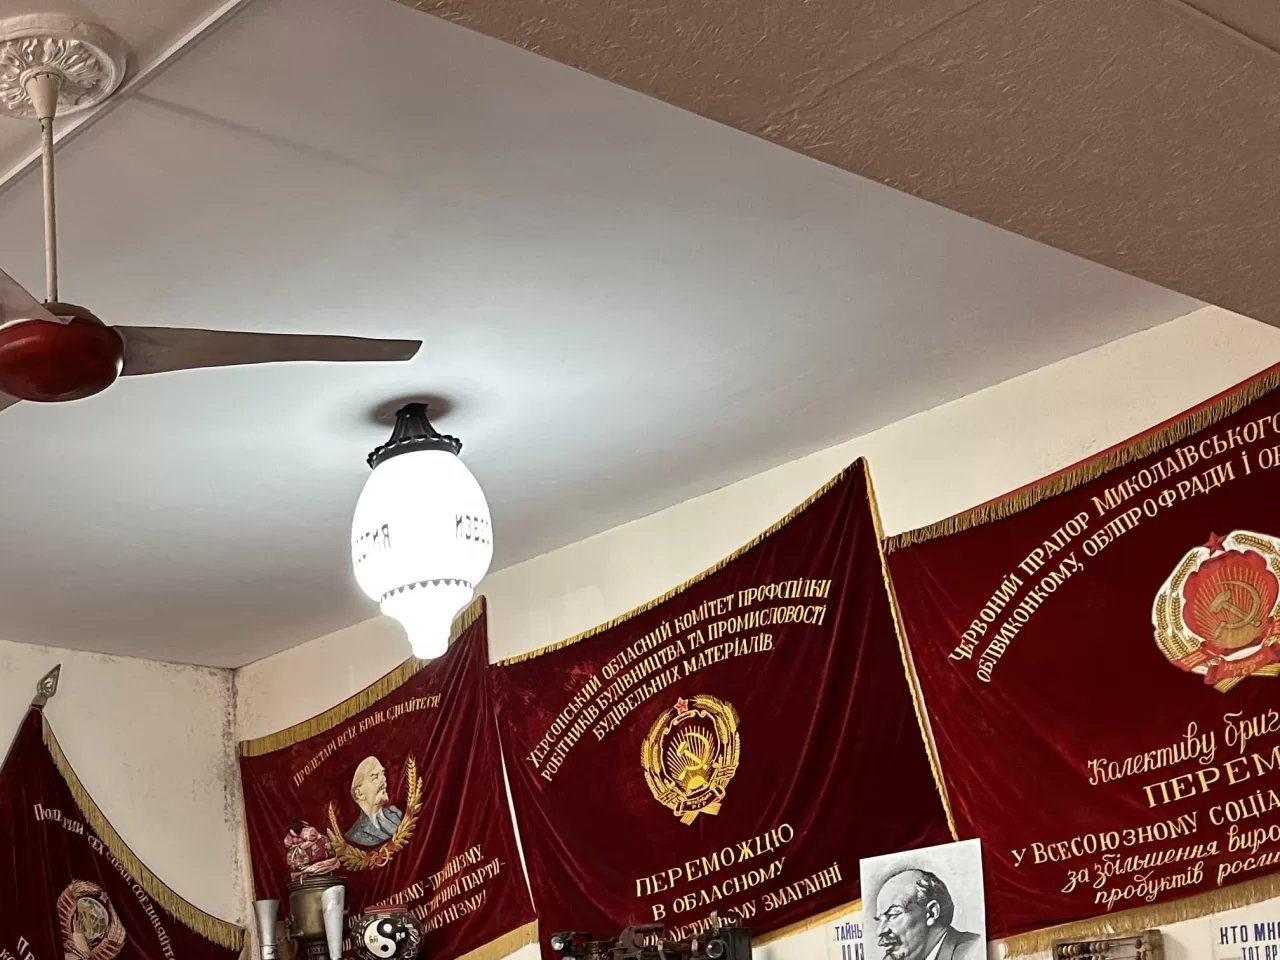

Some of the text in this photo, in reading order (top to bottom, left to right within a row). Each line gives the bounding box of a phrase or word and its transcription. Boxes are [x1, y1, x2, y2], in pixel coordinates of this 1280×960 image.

[949, 575, 1024, 663] ЧЕРВОНИЙ
[1018, 512, 1090, 576] ПРАПОР
[976, 553, 1085, 683] ОБЛВИКОНКОМУ,
[1082, 461, 1236, 557] ОБЛПРОФРАДИ
[526, 578, 832, 768] ХЕРСОНСЬКИЙ ОБЛАСНИЙ КОМІТЕТ ПРОФСПІЛКИ
[541, 604, 827, 782] РОБІТНИКІВ БУДІВНИЦТВА ТА ПРОМИСЛОВОСТІ
[592, 666, 682, 741] БУДІВЕЛЬНИХ
[293, 740, 337, 787] ПРОЛЕТАРІ
[337, 726, 357, 748] ВСІХ
[386, 693, 442, 721] ЄДНАЙТЕСЯ!
[1087, 709, 1280, 786] Колективу бриг
[1142, 746, 1280, 809] ПЕРЕМ
[86, 832, 105, 855] СЕХ
[635, 823, 794, 897] ПЕРЕМОЖЦЮ
[1011, 789, 1280, 868] У ВСЕСОЮЗНОМУ СОЦІА
[652, 857, 786, 921] В ОБЛАСНОМУ
[761, 862, 843, 911] ЗМАГАННІ
[1061, 867, 1090, 893] за
[1093, 840, 1220, 889] збільшення
[1094, 861, 1204, 912] продуктів
[423, 889, 487, 933] ОМУНІЗМУ!
[1220, 926, 1248, 945] КТО
